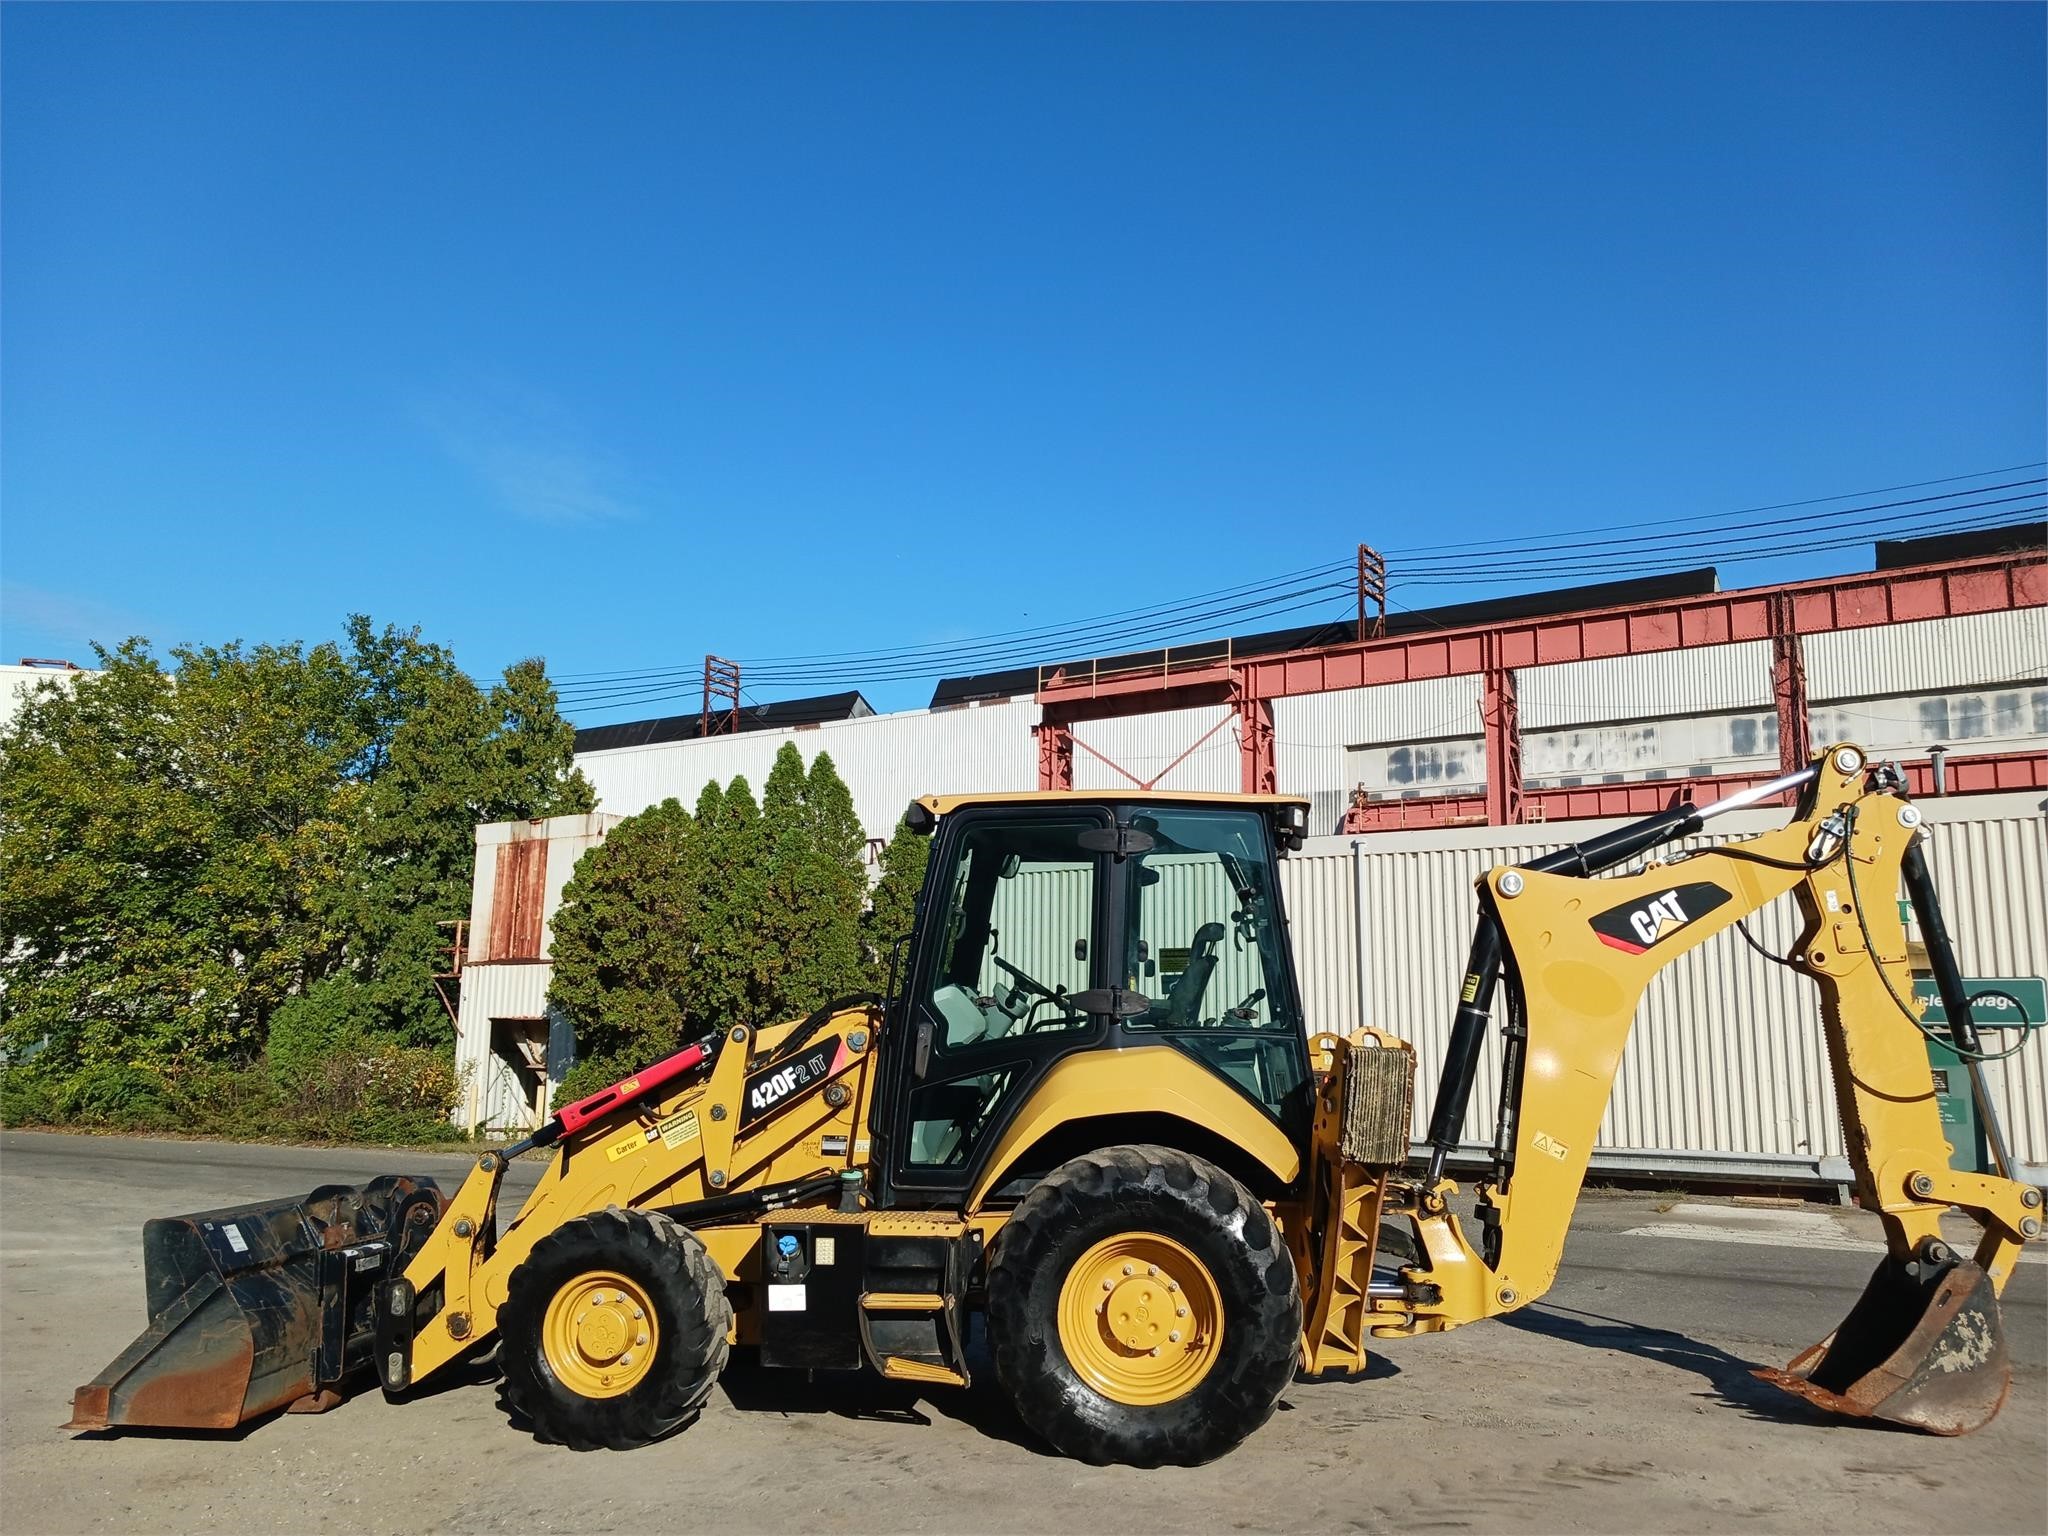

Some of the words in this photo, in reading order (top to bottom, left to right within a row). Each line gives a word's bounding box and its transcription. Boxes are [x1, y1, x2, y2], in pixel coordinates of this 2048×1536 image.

[1629, 889, 1689, 944] CAT
[751, 1065, 810, 1109] 420F2
[808, 1053, 826, 1076] IT
[661, 1112, 694, 1132] WARNING
[645, 1128, 658, 1141] CAT
[615, 1140, 637, 1155] Carter
